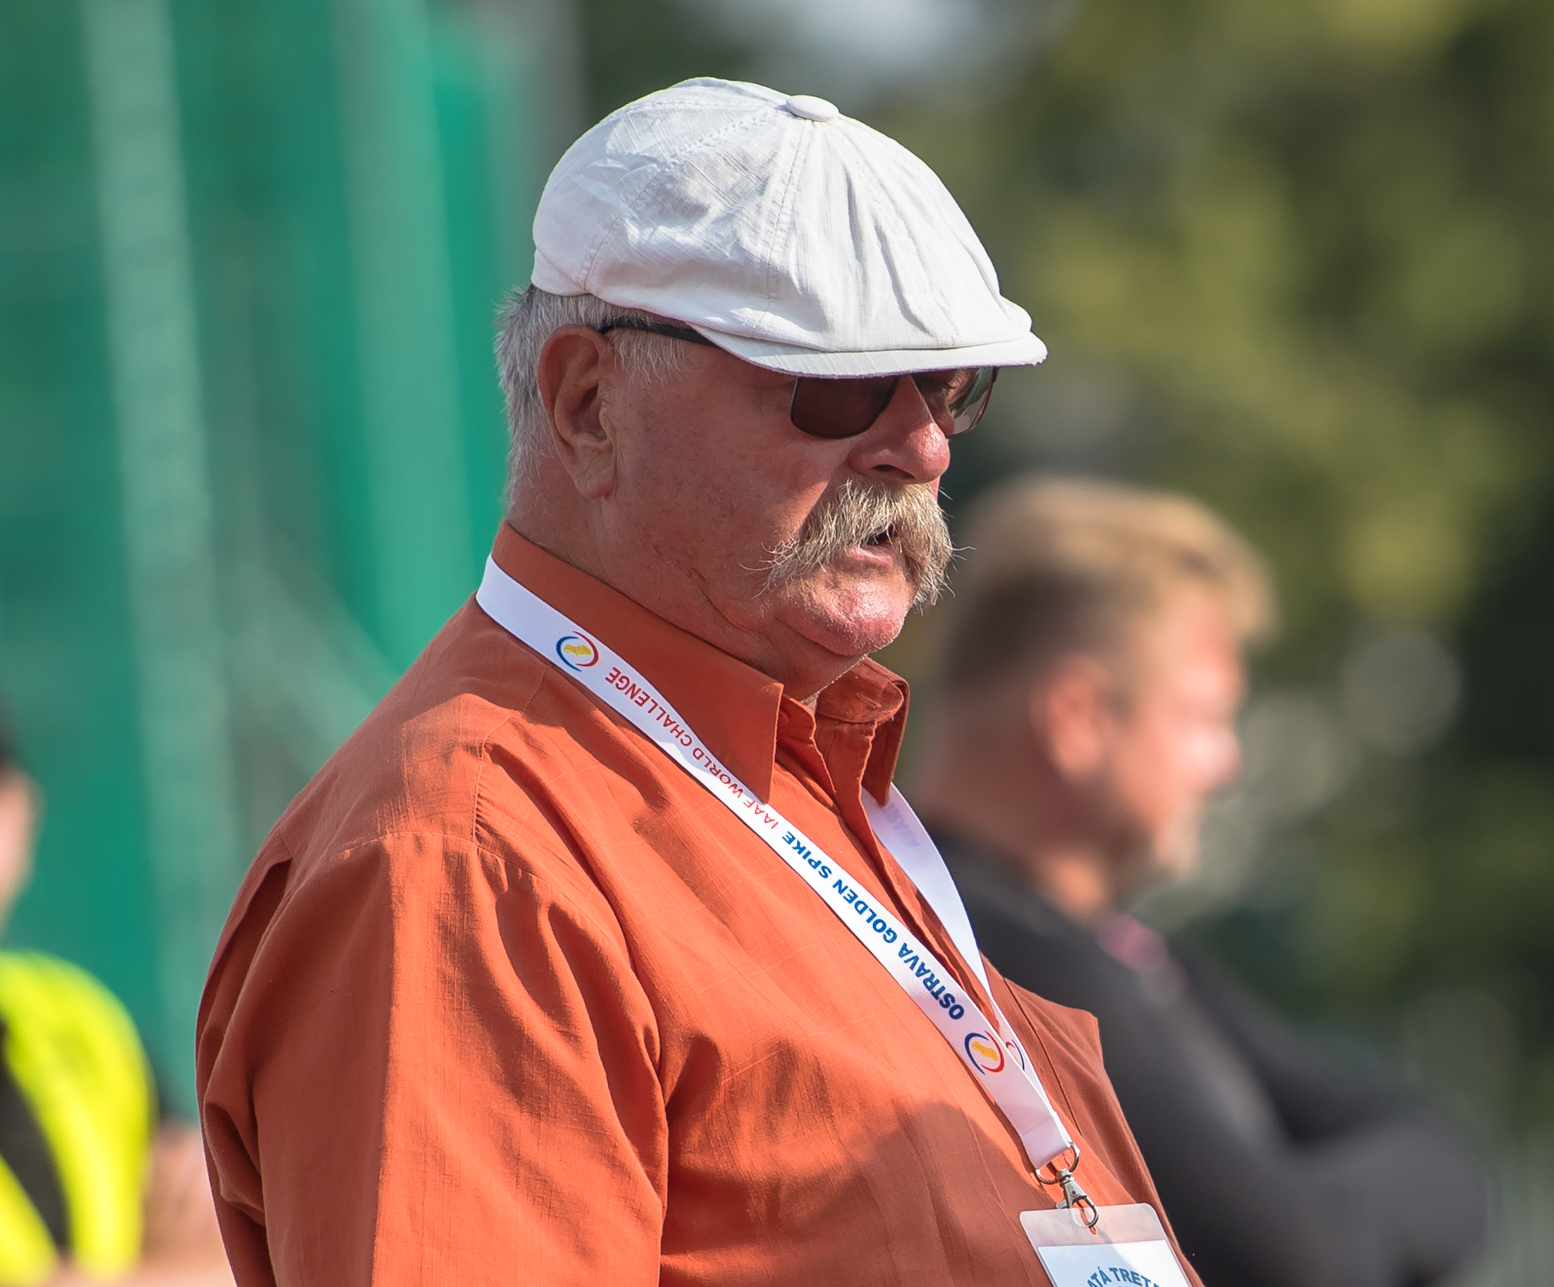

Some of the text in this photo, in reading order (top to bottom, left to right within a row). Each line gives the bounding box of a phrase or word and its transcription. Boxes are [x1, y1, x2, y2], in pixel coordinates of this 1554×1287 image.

[605, 665, 779, 829] IAAF WORLD CHALLENGE
[781, 830, 965, 1021] OSTRAVA GOLDEN SPIKE
